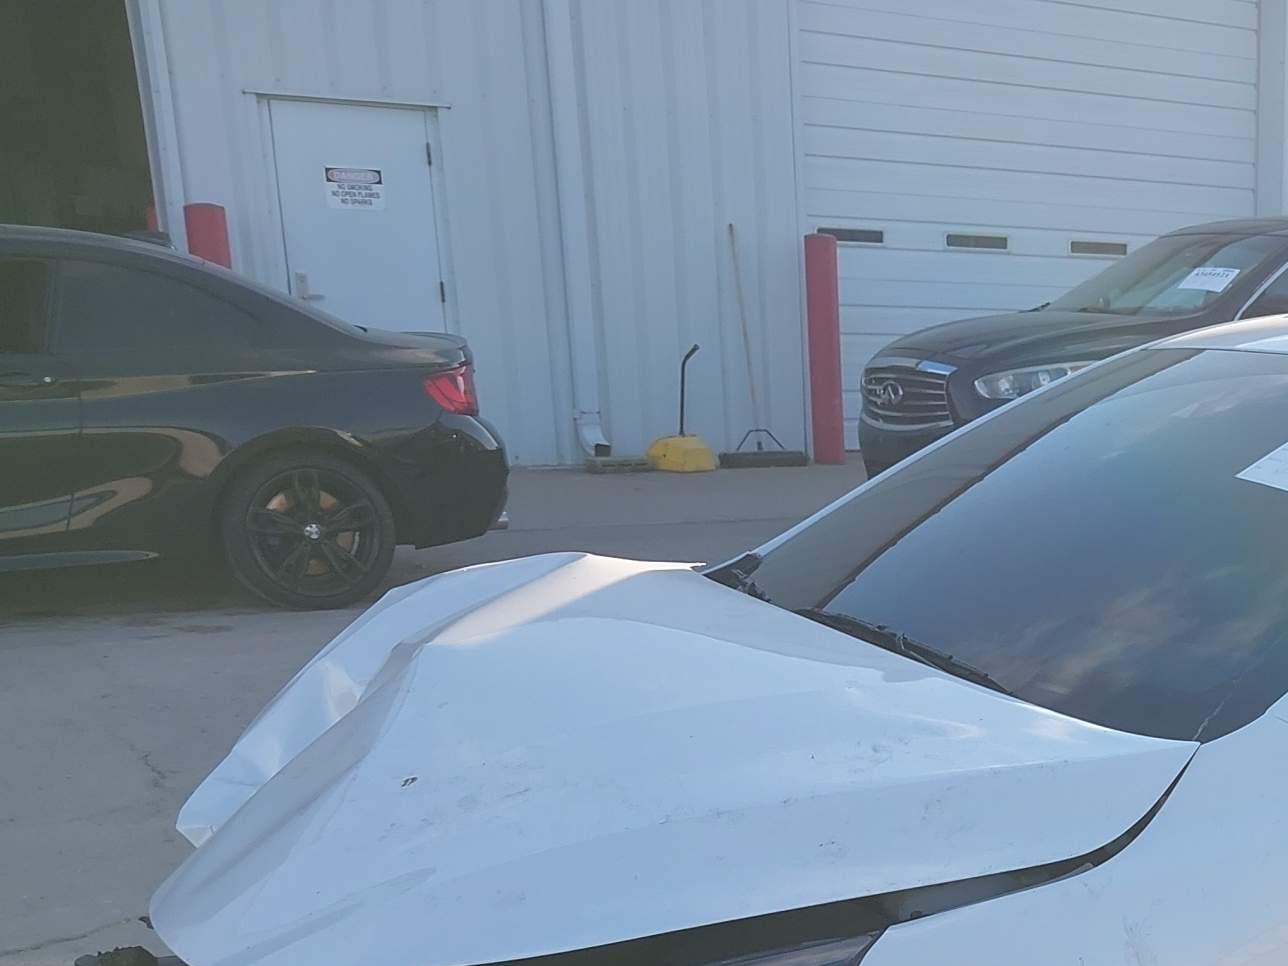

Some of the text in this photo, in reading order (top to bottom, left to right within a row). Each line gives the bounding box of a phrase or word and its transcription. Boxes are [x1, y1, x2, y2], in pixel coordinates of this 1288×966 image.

[347, 184, 373, 192] SMOKING
[341, 190, 356, 198] OPEN
[358, 191, 380, 199] FLAMES
[350, 198, 373, 206] SPARKS
